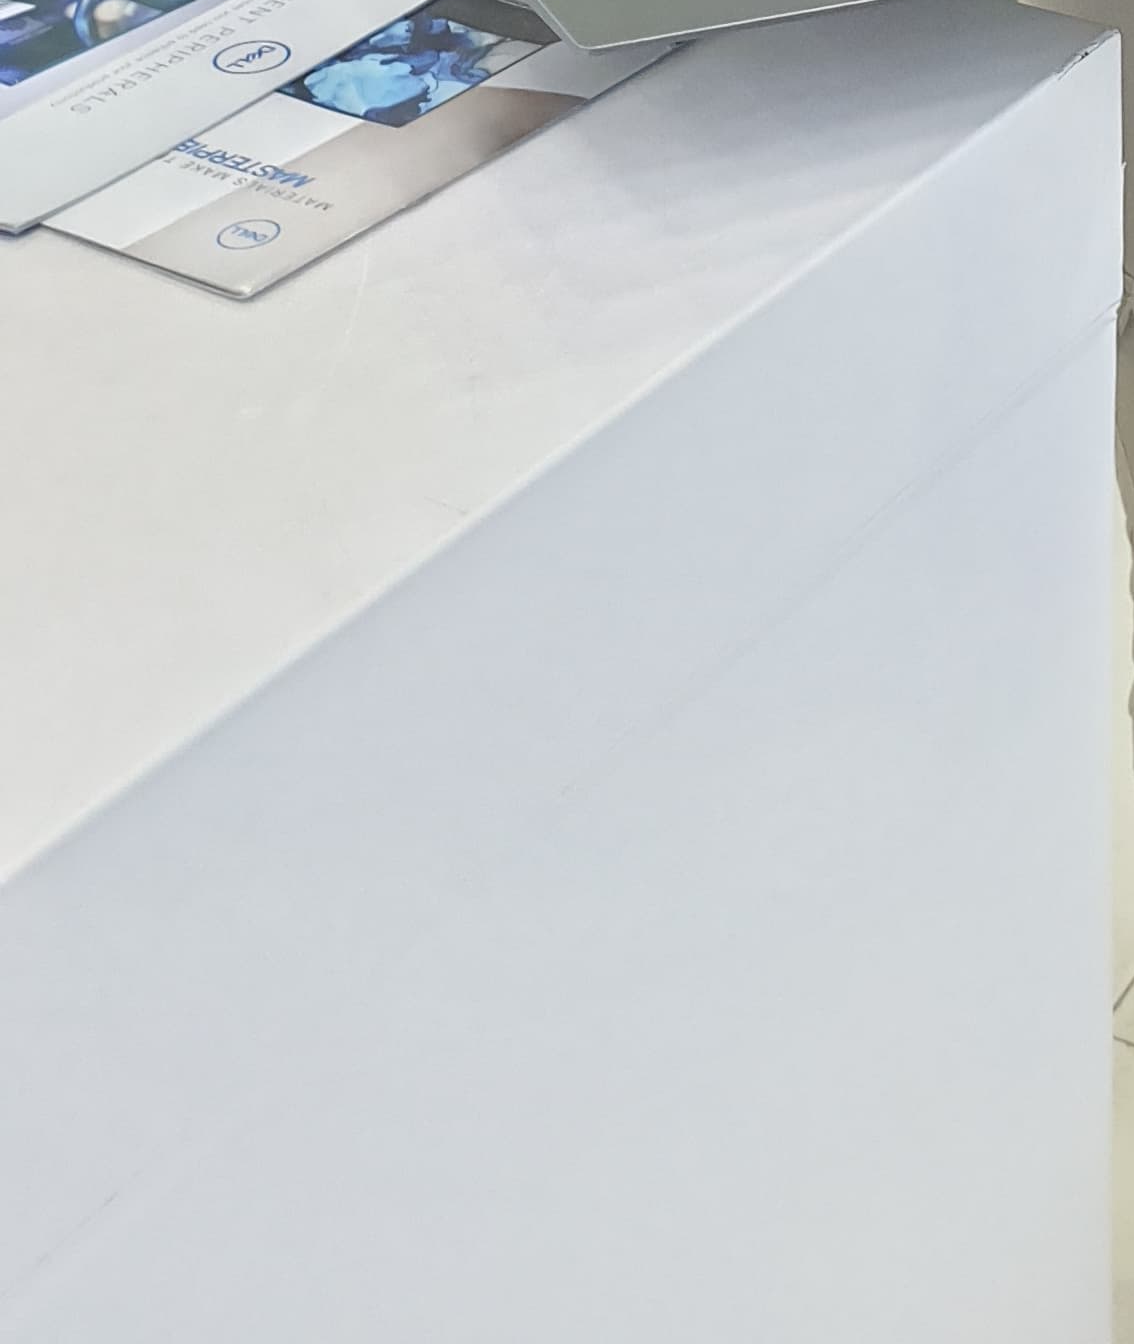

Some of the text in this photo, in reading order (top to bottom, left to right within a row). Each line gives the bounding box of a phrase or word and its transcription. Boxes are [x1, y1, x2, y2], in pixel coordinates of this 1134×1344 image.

[70, 25, 236, 115] PERIPHERALS
[179, 160, 232, 183] MAKE
[231, 176, 335, 212] MATERIALS
